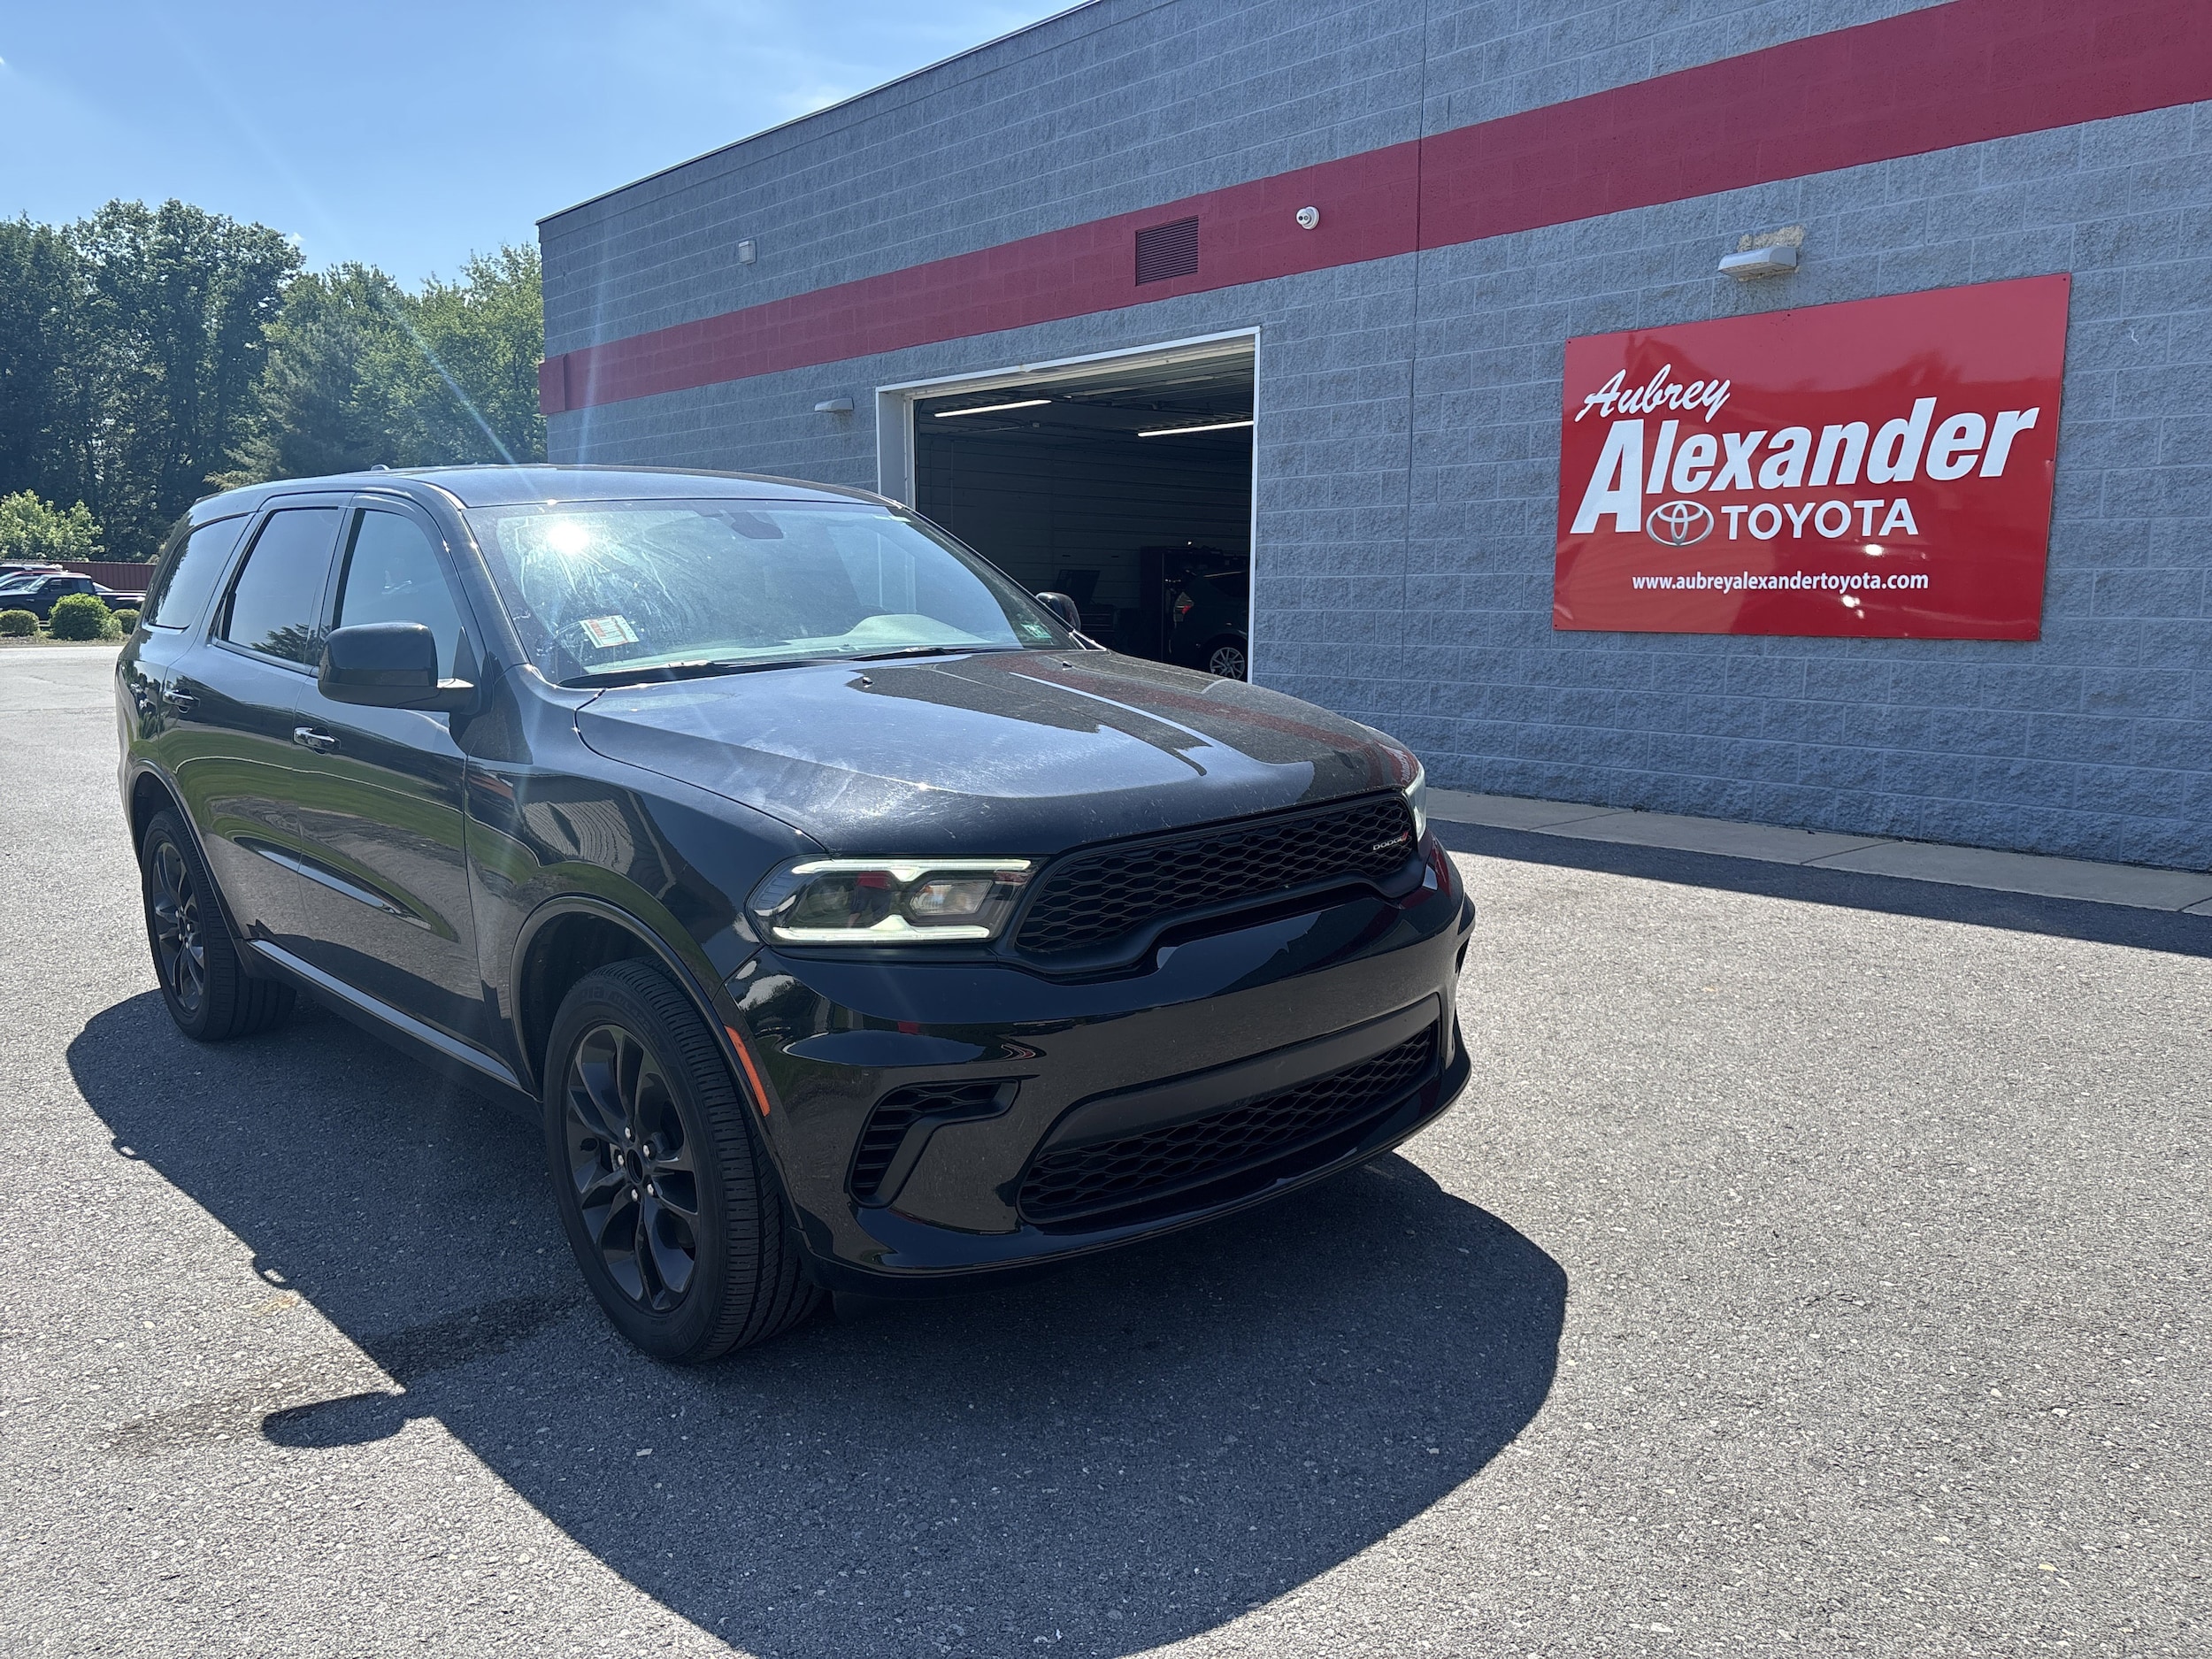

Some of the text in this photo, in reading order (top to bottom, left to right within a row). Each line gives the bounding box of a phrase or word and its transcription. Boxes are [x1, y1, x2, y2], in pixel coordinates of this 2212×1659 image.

[1575, 363, 1731, 423] Aubrey
[1569, 396, 2040, 534] Alexander
[1721, 497, 1919, 540] TOYOTA
[1632, 571, 1929, 595] www.aubreyalexandertoyota.com
